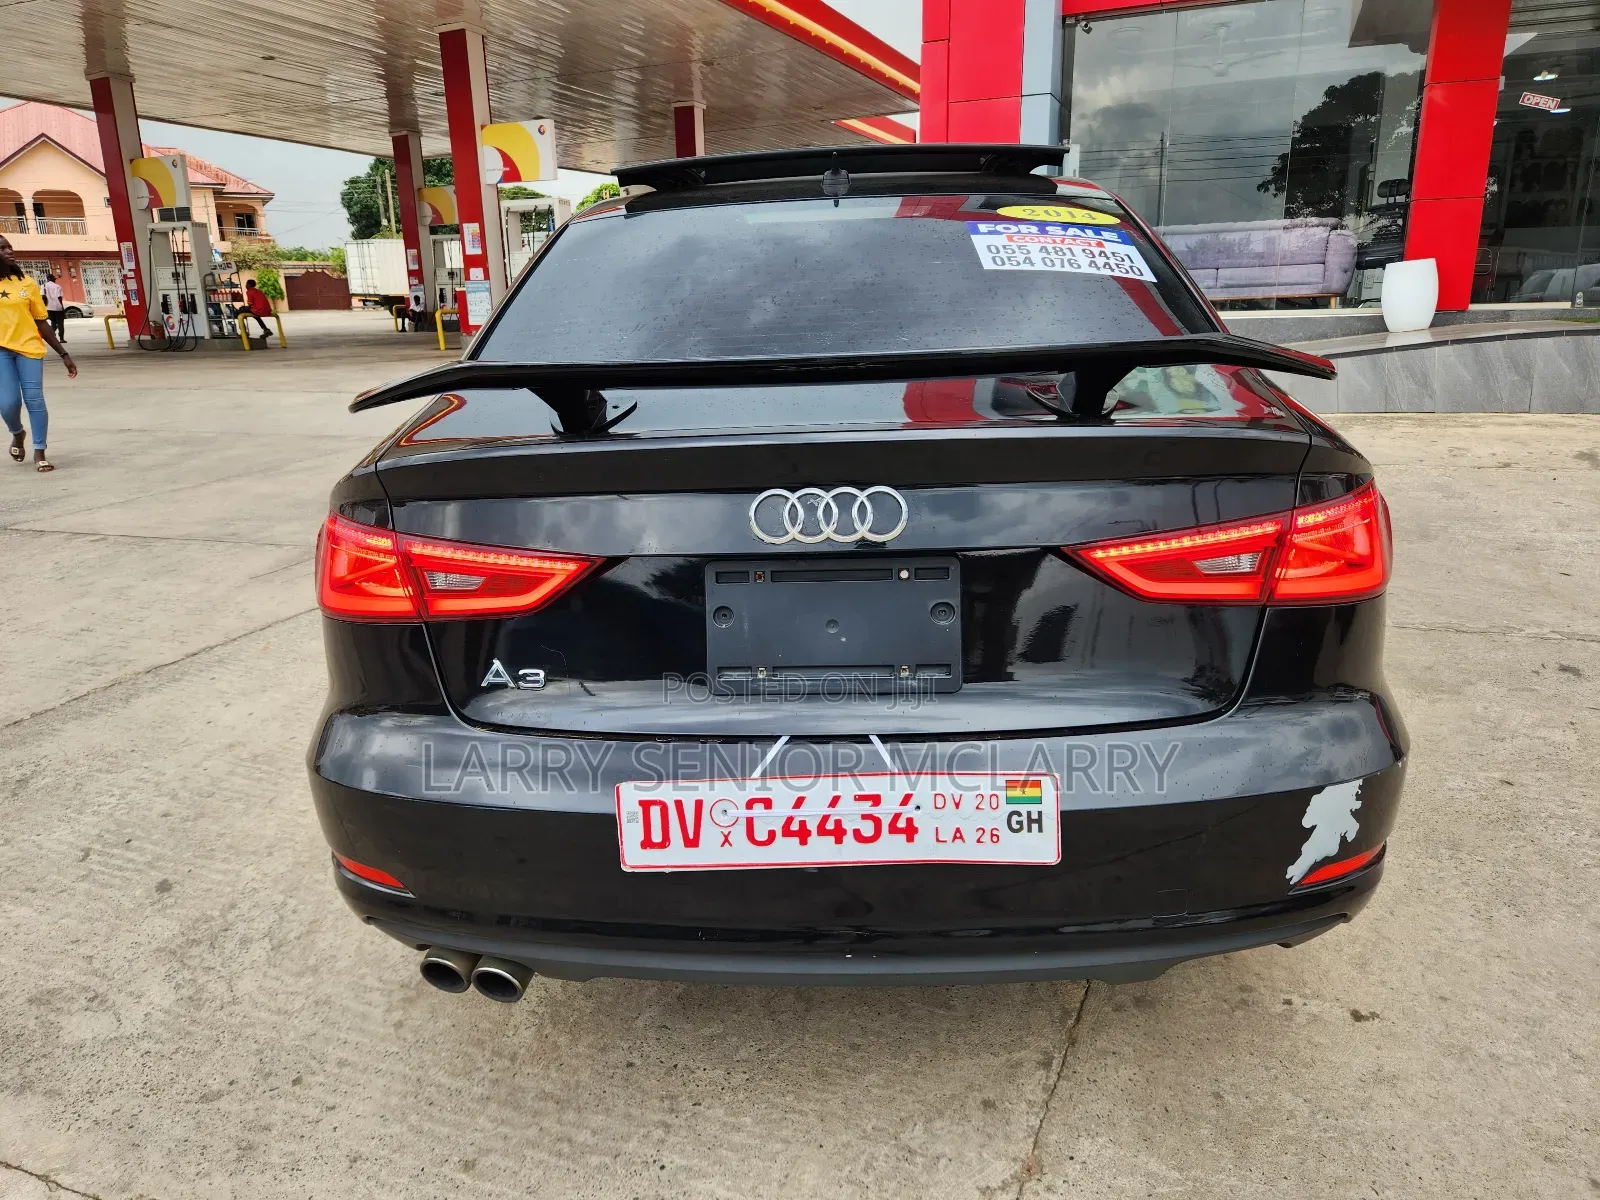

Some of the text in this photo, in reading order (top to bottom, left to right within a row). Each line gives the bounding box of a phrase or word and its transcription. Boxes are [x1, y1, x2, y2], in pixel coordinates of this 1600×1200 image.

[1524, 94, 1556, 109] OPEN
[1022, 208, 1096, 221] 2014
[977, 223, 1121, 241] FOR SALE
[1012, 236, 1097, 247] CONTACT
[986, 244, 1135, 264] 055 481 9451
[992, 255, 1143, 276] 054 076 4450
[480, 657, 546, 691] A3
[933, 793, 1000, 811] DV 20
[638, 798, 703, 850] DV
[1006, 810, 1044, 833] GH
[935, 827, 1000, 843] LA 26
